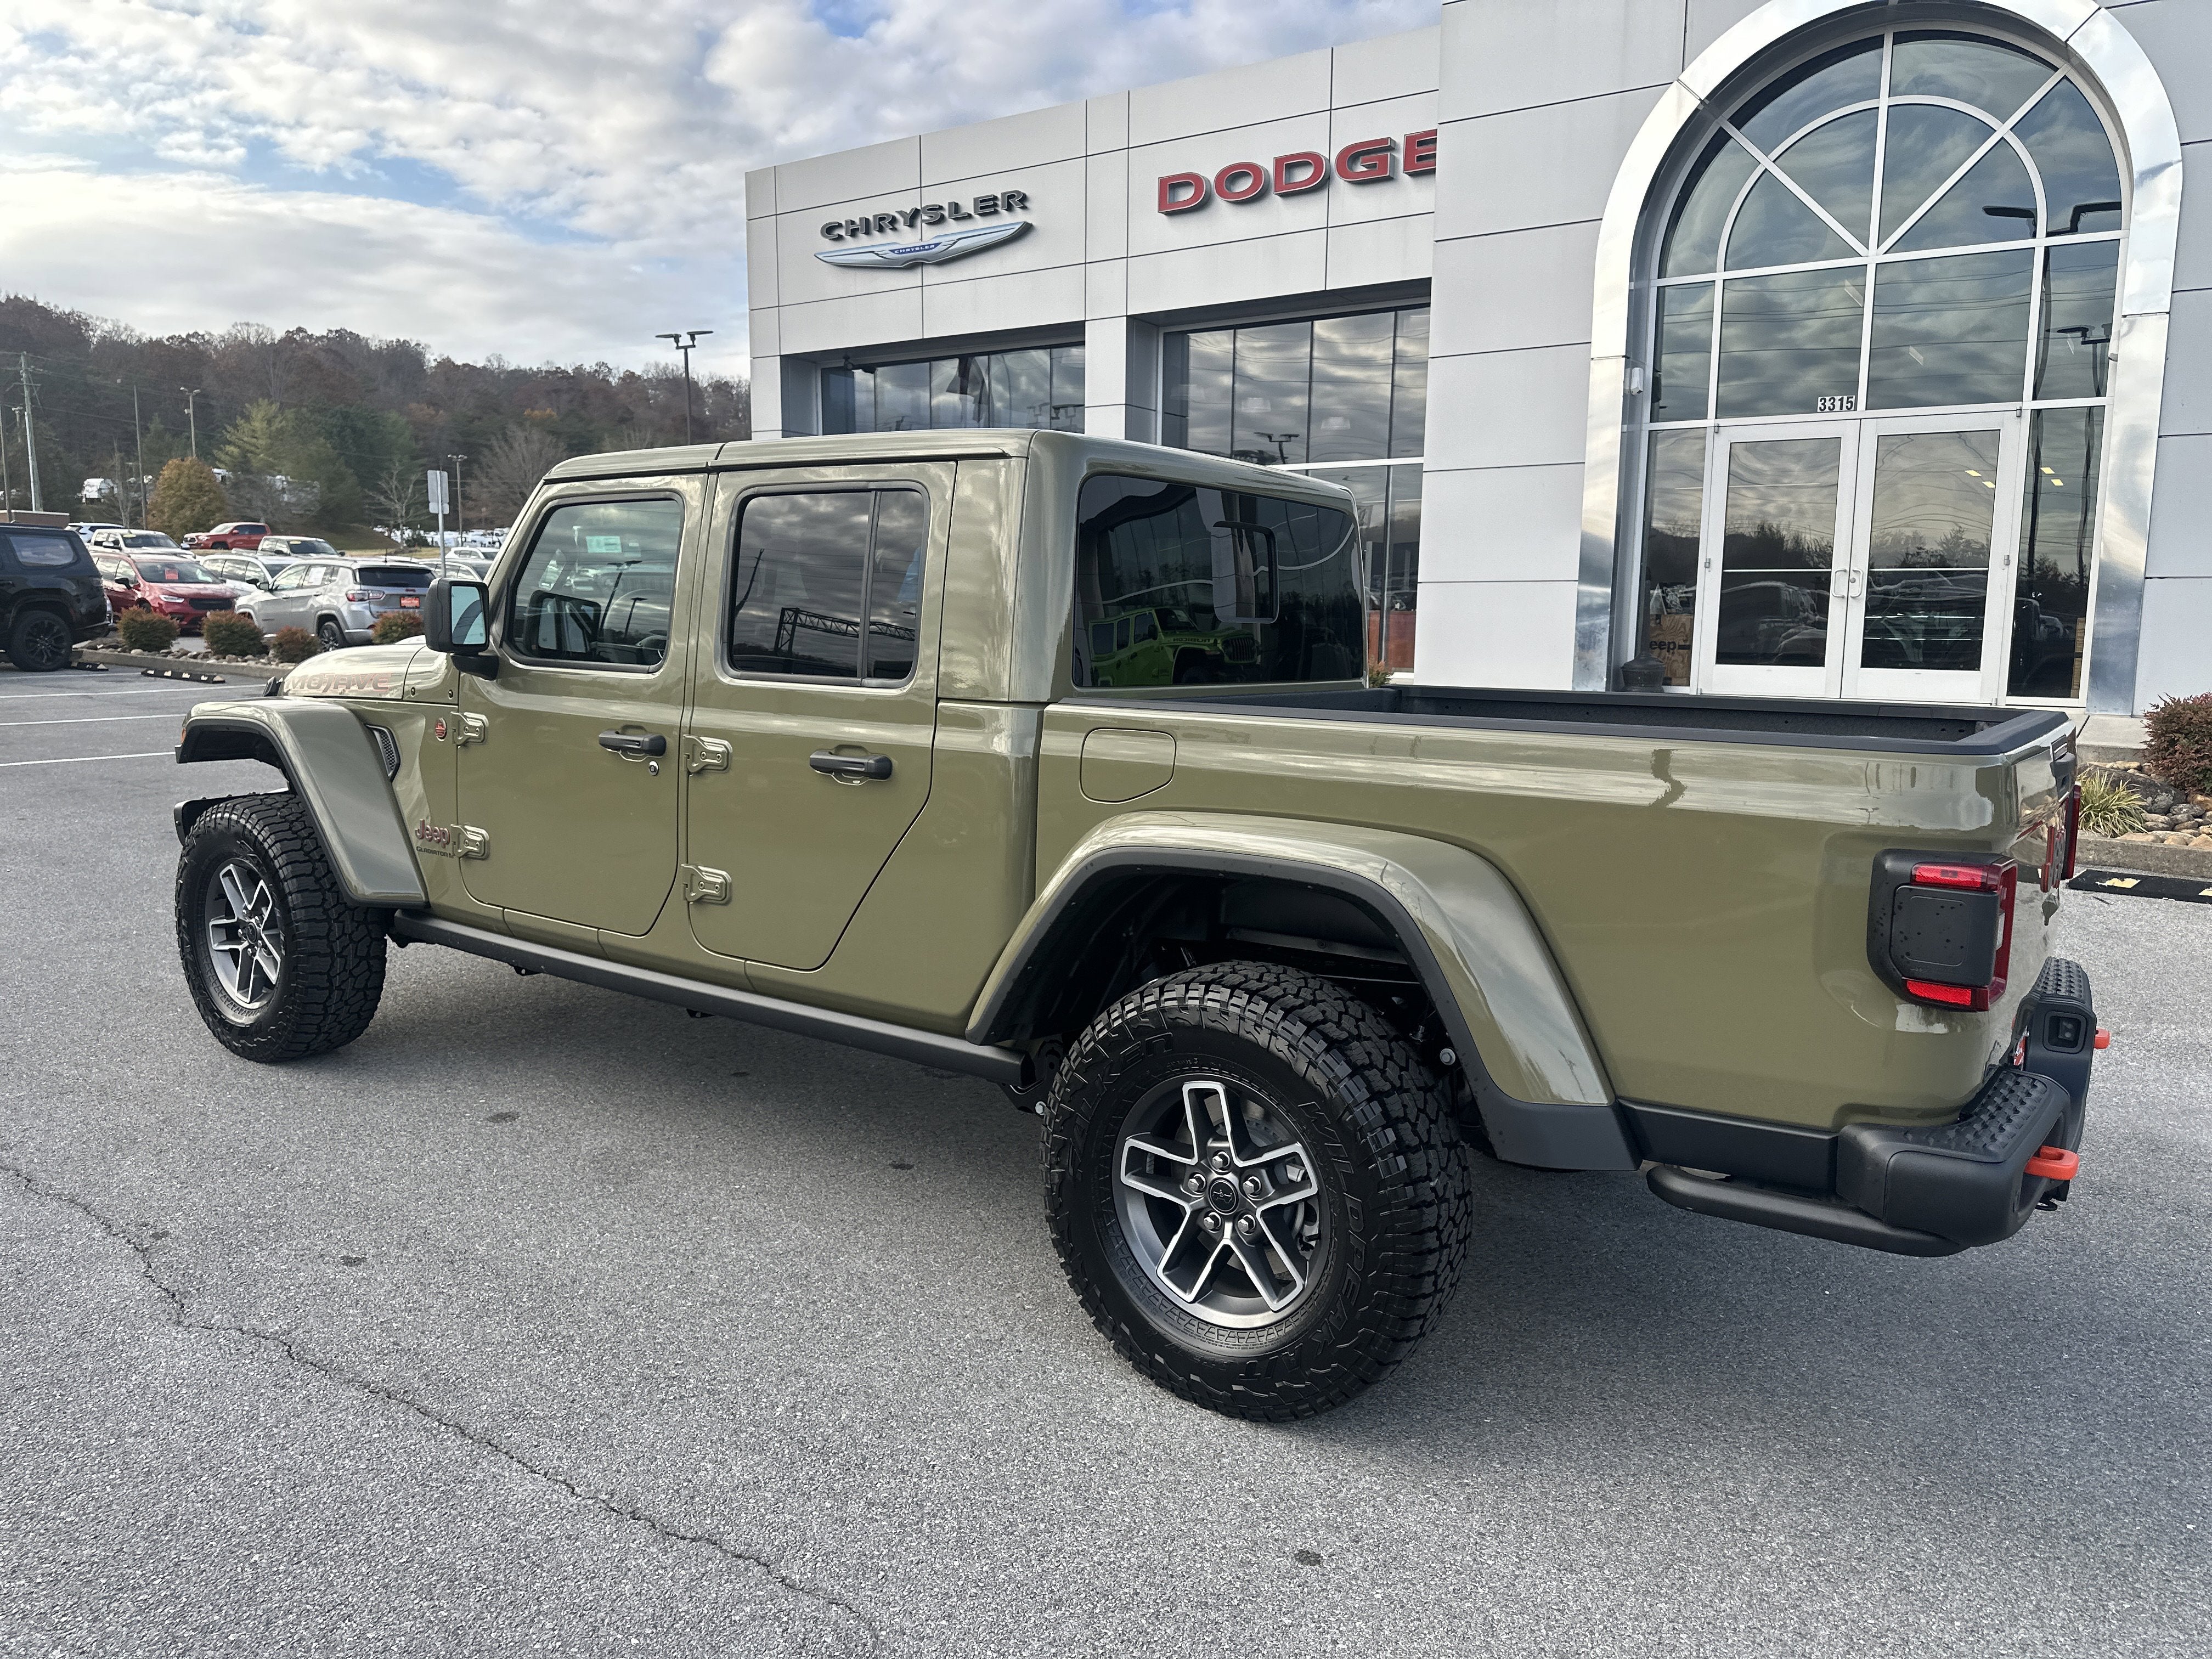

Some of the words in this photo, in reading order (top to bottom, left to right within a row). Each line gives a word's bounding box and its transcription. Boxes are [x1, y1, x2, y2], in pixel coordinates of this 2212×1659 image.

[1158, 128, 1437, 214] DODGE
[820, 190, 1026, 240] CHRYSLER
[894, 245, 935, 253] CHRYSLER
[1819, 396, 1854, 411] 3315
[1649, 641, 1677, 653] eep
[284, 673, 392, 693] MOJAVE
[415, 819, 450, 849] Jeep
[416, 846, 448, 857] GLADIATOR
[1298, 1099, 1367, 1356] WILDPEAK
